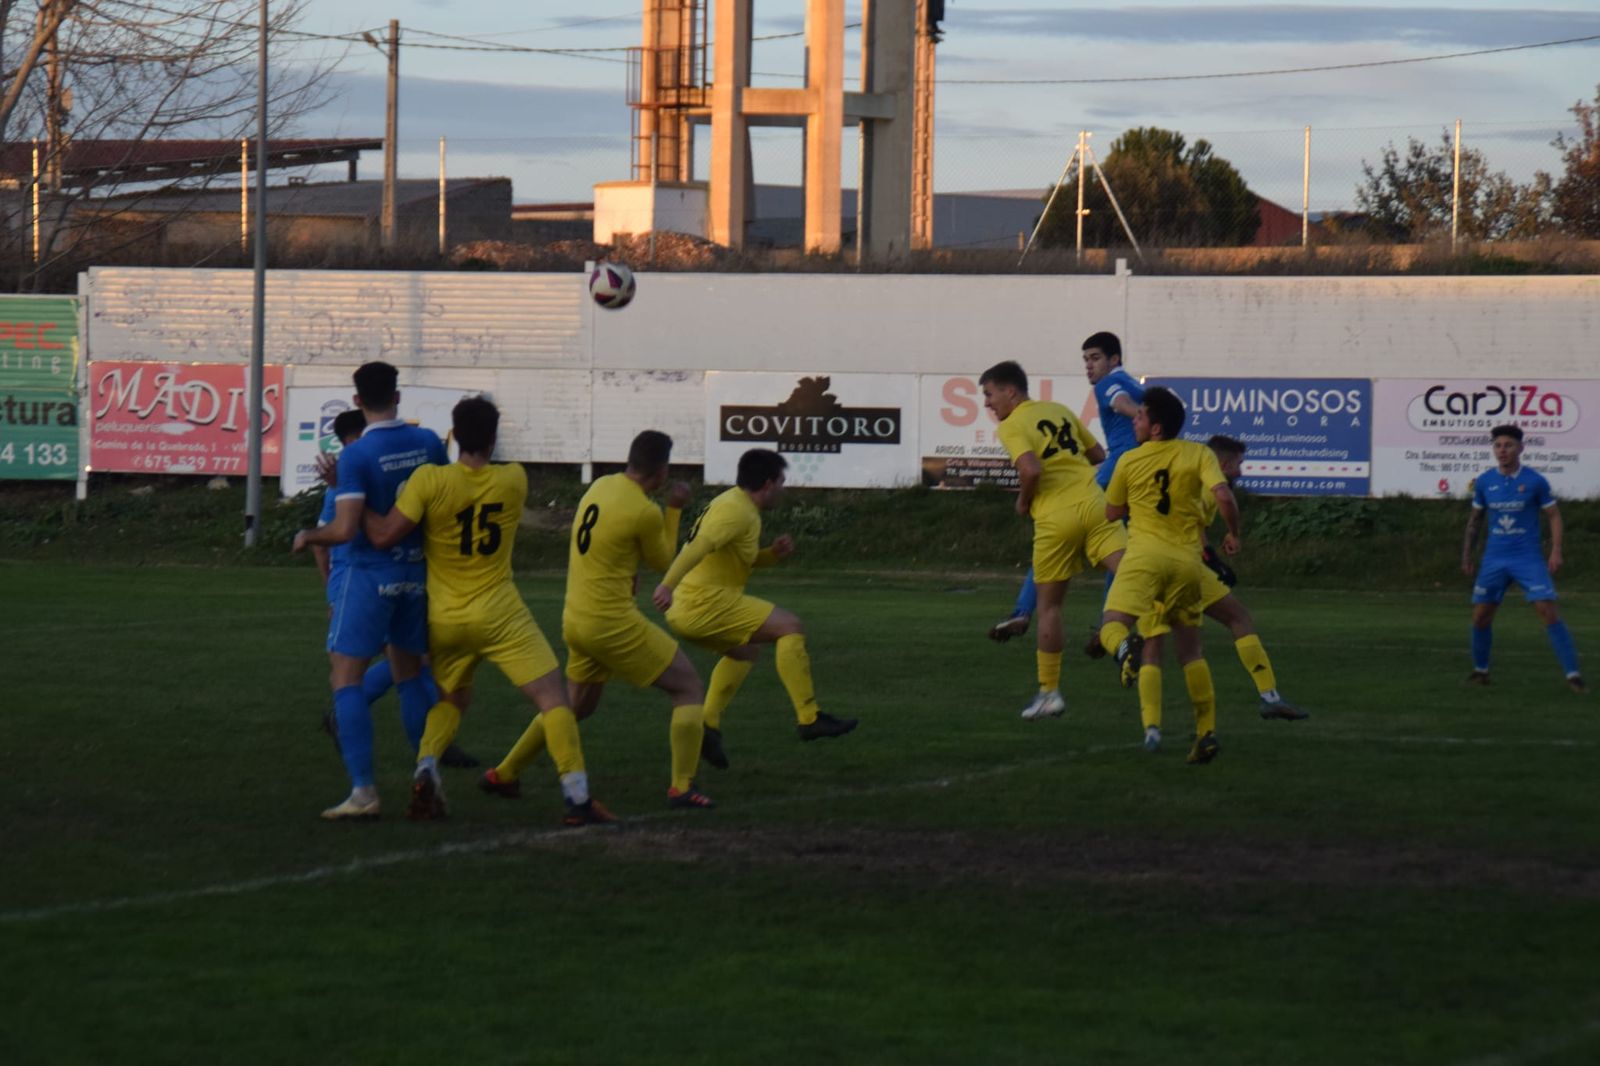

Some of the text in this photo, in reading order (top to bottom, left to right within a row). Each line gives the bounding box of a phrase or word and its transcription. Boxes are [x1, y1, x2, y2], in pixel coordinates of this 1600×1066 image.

[1192, 388, 1361, 414] LUMINOSOS
[725, 414, 896, 437] COVITORO
[1192, 415, 1361, 428] ZAMORA
[1423, 418, 1492, 428] EMBUTIDOS
[781, 443, 838, 452] BODEGAS
[1037, 418, 1079, 459] 24
[1276, 433, 1328, 443] Luminosos
[23, 442, 69, 467] 133
[144, 455, 172, 469] 675
[212, 456, 241, 471] 777
[1279, 447, 1349, 460] Merchandising
[1154, 468, 1171, 516] 3
[456, 502, 503, 557] 15
[576, 503, 600, 556] 8
